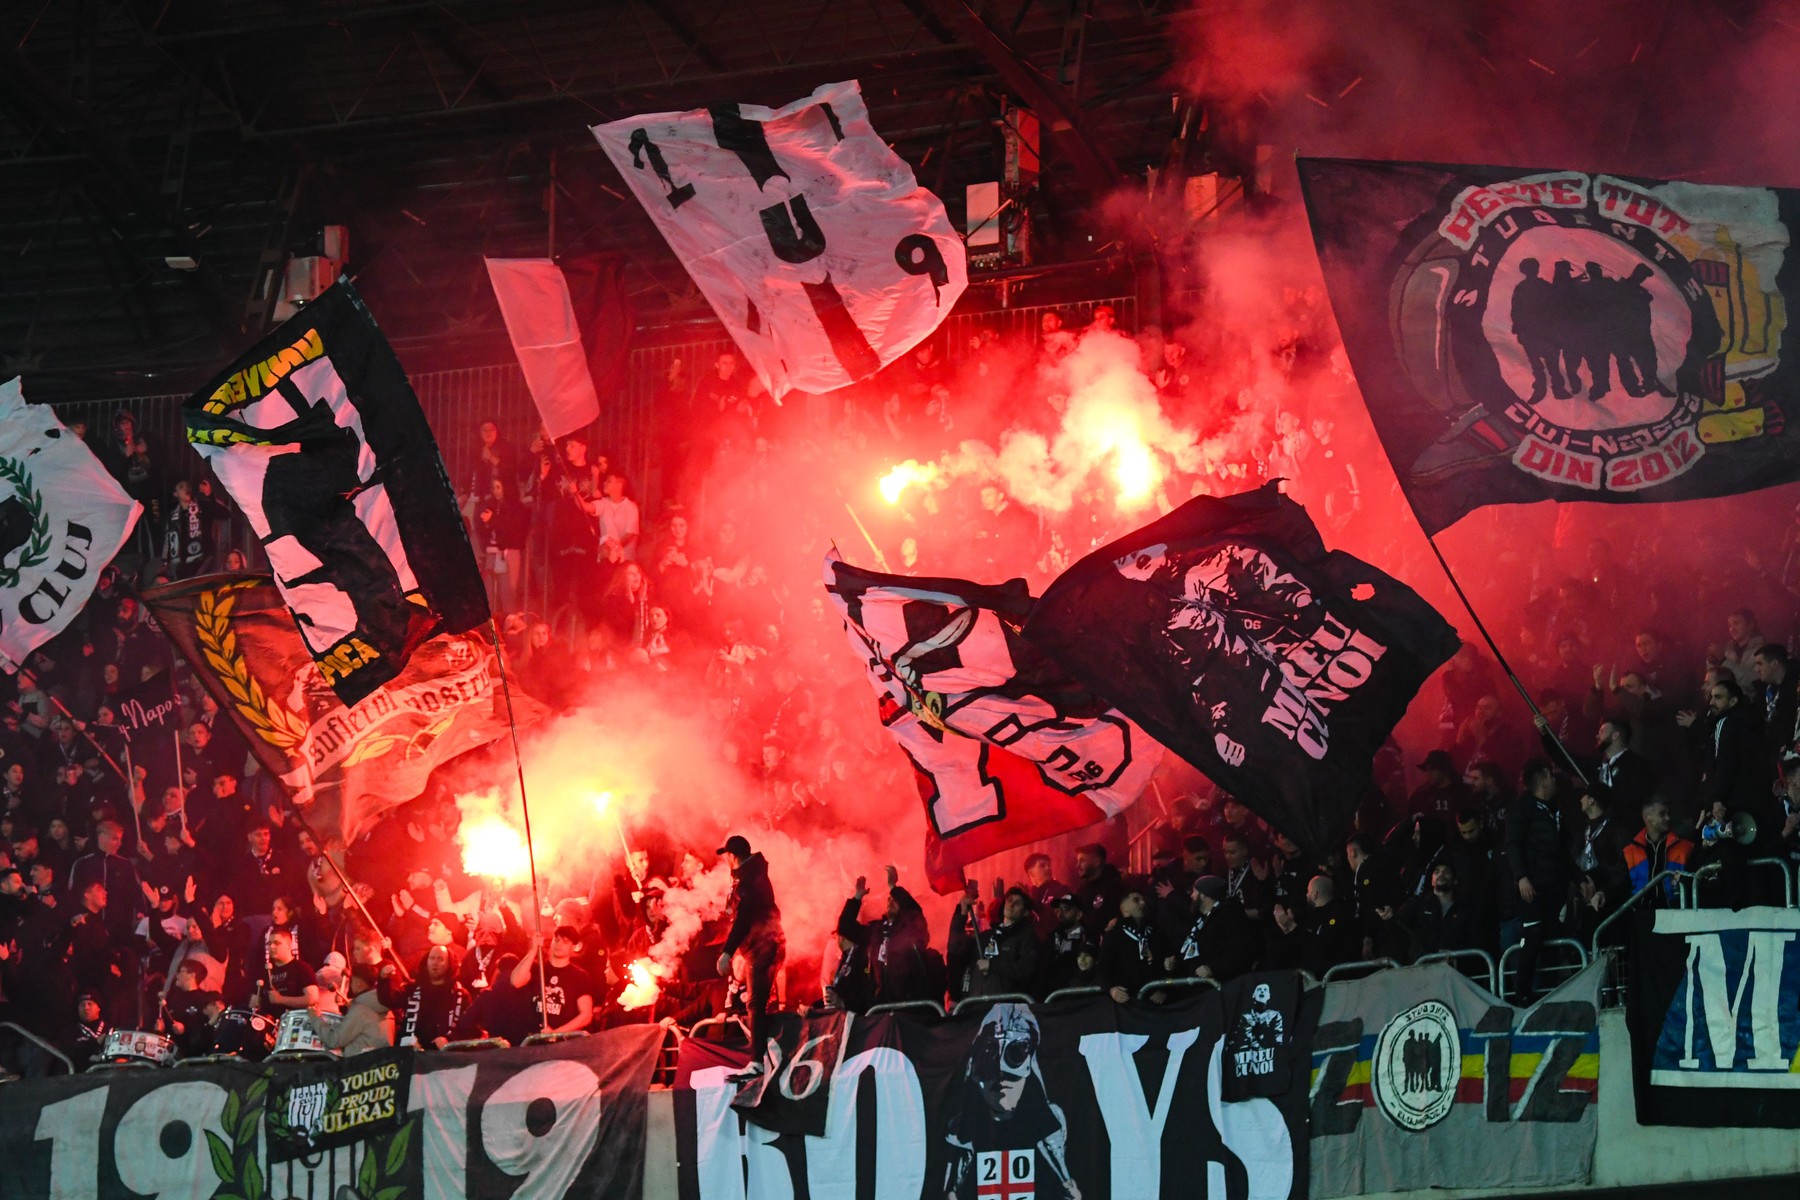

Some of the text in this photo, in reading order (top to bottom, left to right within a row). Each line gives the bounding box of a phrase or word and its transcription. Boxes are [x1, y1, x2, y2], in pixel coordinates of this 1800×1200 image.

[1600, 183, 1691, 235] TOT
[1519, 430, 1701, 487] DIN 2012
[18, 519, 94, 625] CLUJ
[1304, 628, 1388, 718] NOI
[340, 1063, 400, 1093] YOUNG,
[1249, 1059, 1275, 1076] NOI
[323, 1098, 396, 1134] ULTRAS
[339, 1085, 395, 1111] PROUD,
